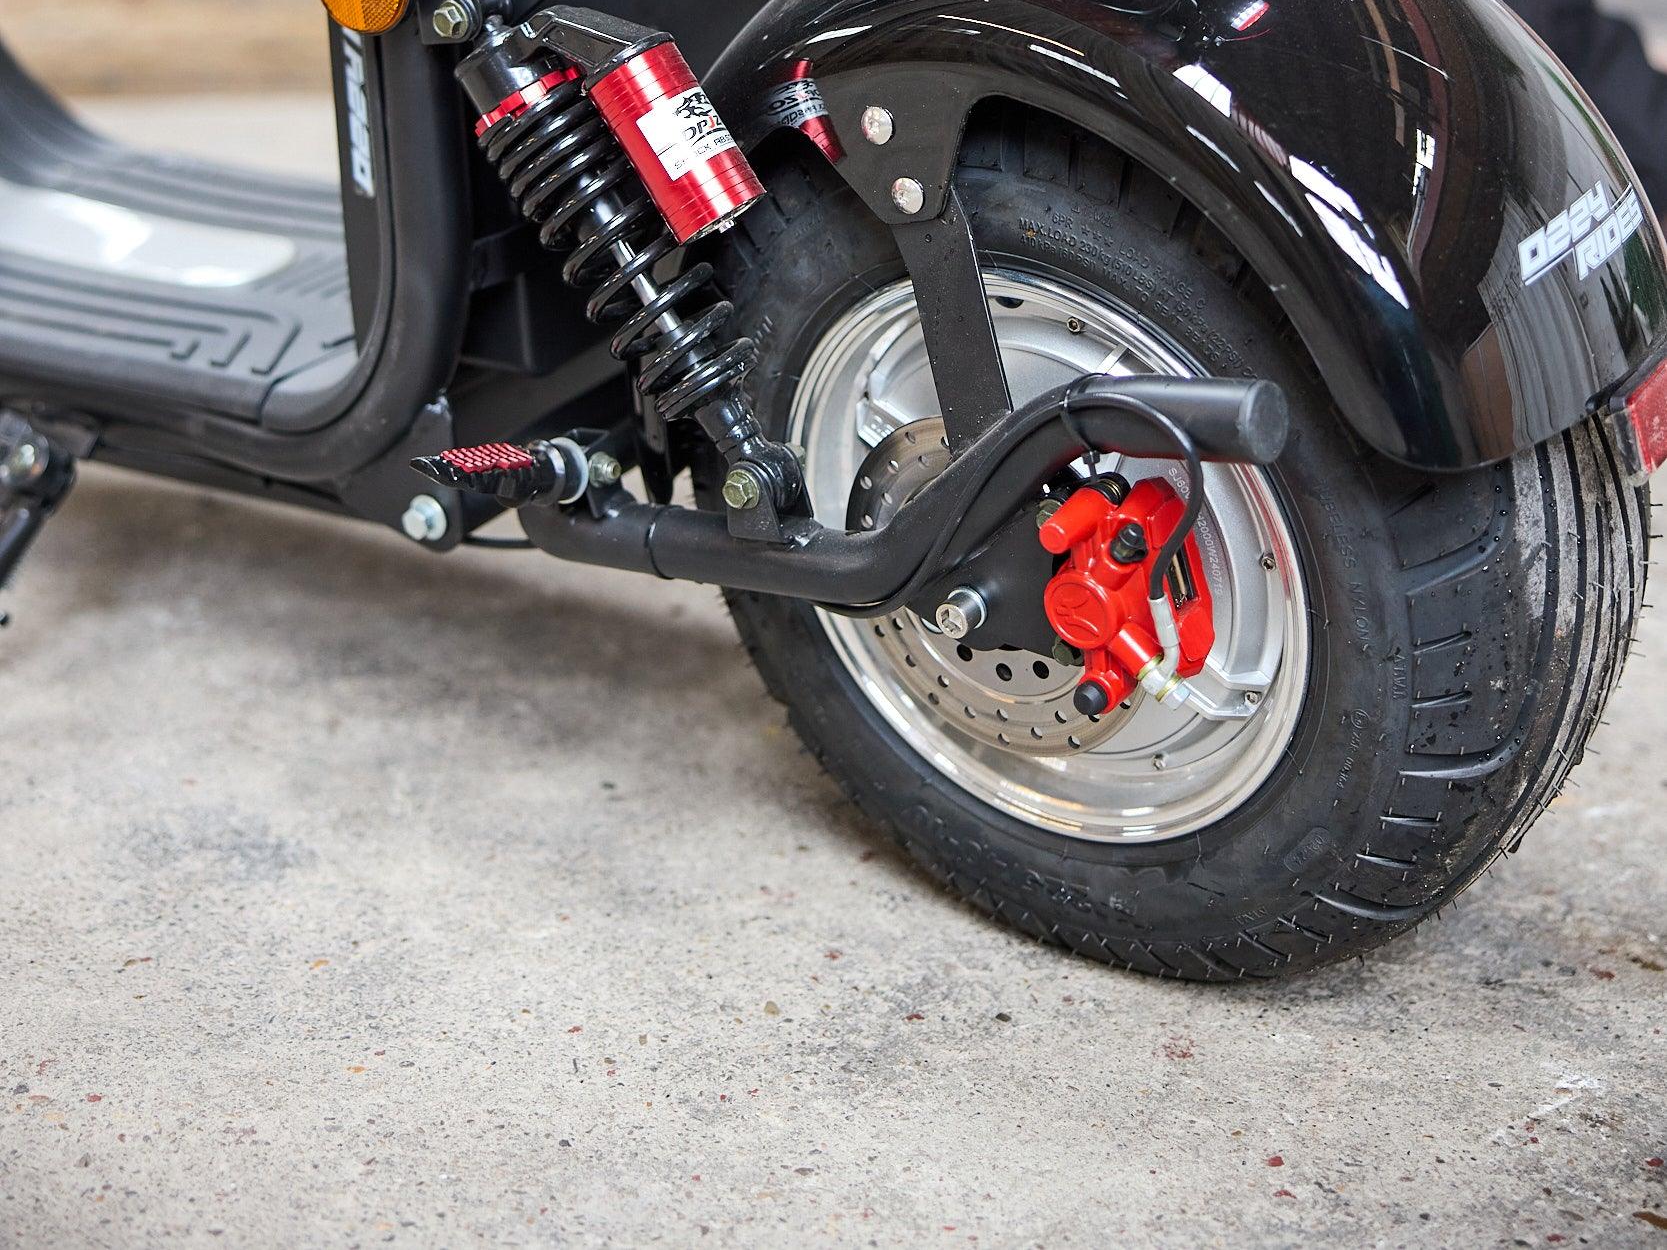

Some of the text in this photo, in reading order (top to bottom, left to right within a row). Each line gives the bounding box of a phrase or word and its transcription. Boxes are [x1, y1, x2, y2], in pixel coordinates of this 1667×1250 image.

[1119, 242, 1152, 269] LOAD
[1154, 263, 1194, 301] RANGE
[1573, 188, 1644, 281] RIDES
